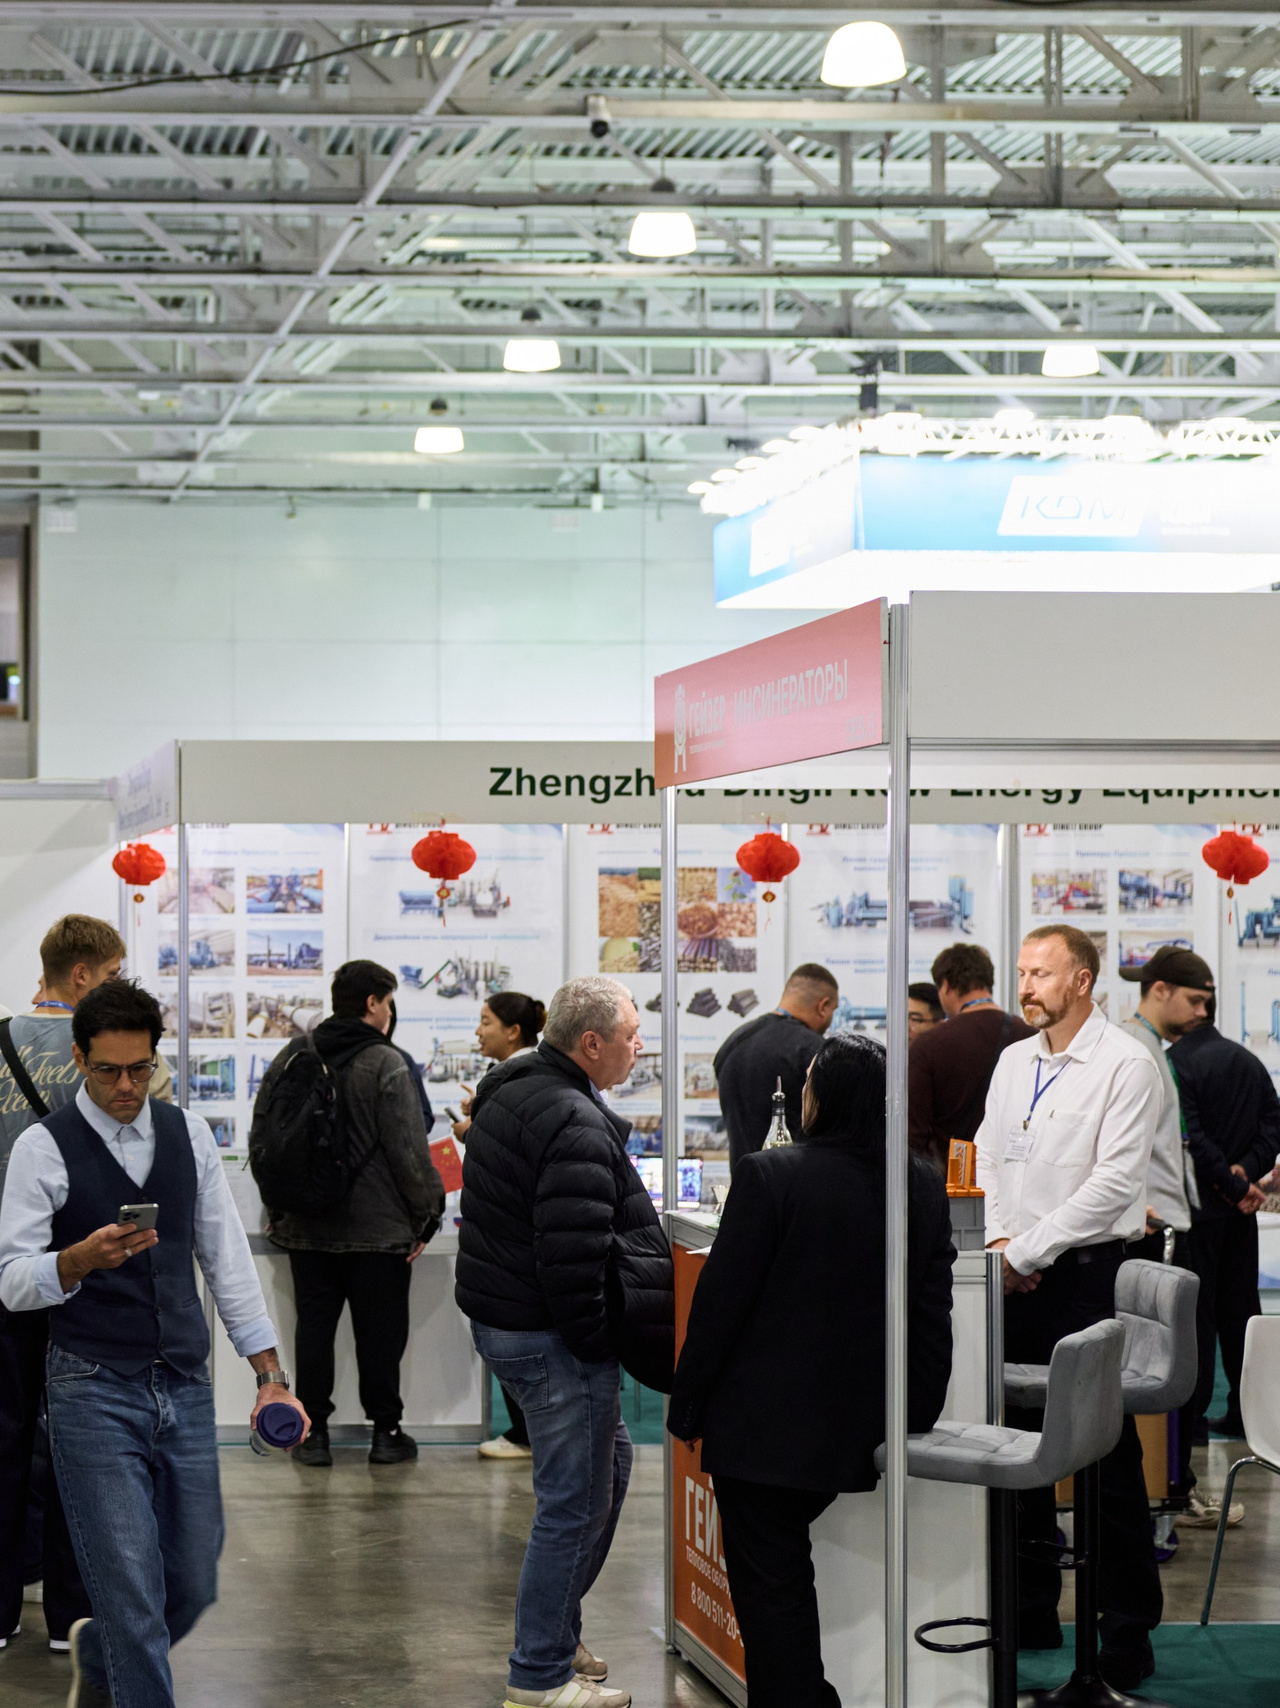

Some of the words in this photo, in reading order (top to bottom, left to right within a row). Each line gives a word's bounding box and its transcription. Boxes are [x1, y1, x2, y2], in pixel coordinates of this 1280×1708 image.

[689, 691, 725, 738] ГЕЙЗЕР
[734, 659, 848, 725] ИНСИНЕРАТОРЫ
[686, 1545, 711, 1580] ТЕПЛОВОЕ
[691, 1581, 696, 1604] 8
[697, 1587, 711, 1619] 800
